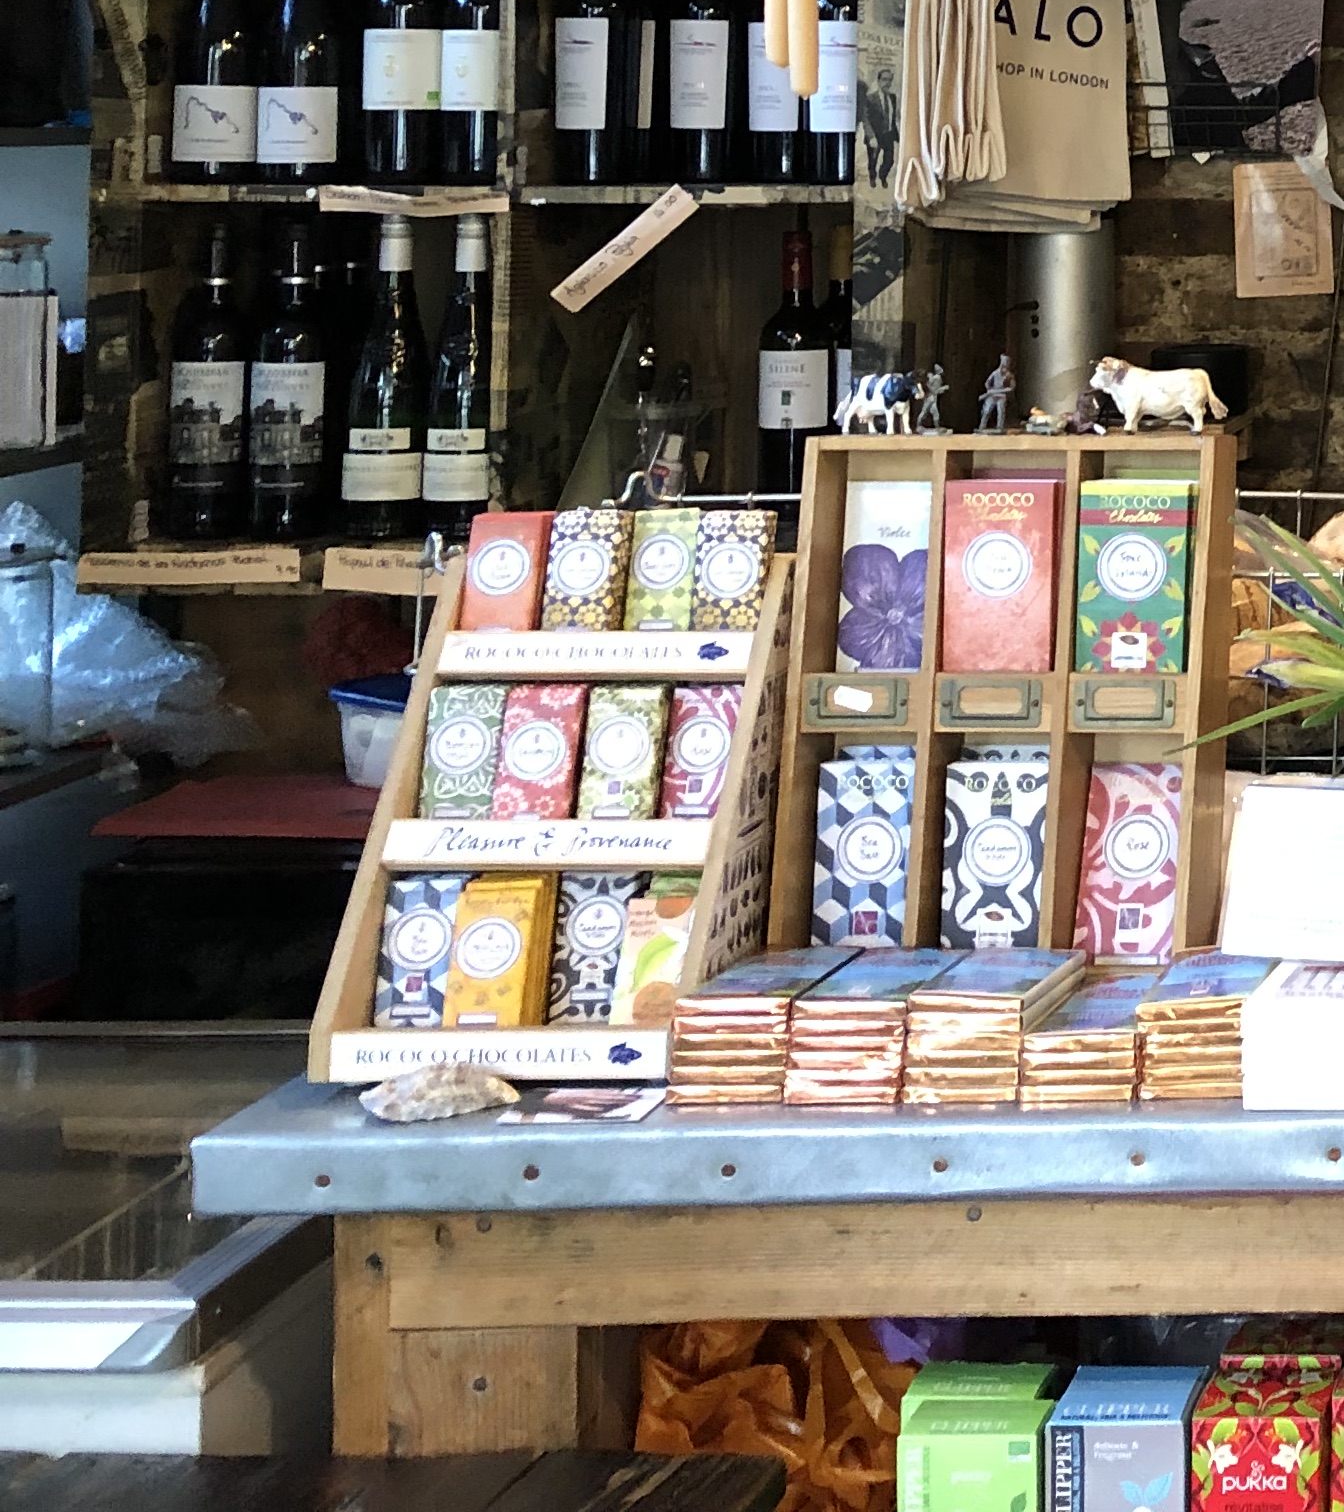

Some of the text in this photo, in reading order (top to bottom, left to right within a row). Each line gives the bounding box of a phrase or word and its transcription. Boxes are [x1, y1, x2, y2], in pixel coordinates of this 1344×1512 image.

[996, 61, 1109, 90] HOP IN LONDON
[963, 492, 1034, 508] ROCOCO
[1101, 495, 1171, 509] ROCOCO
[424, 826, 526, 859] Pleasure
[562, 826, 673, 857] Provenance
[1125, 836, 1150, 852] Rose
[356, 1048, 592, 1065] ROCOCO CHOCOLATES
[1053, 1433, 1072, 1512] LIPPER
[1221, 1472, 1288, 1495] pukka
